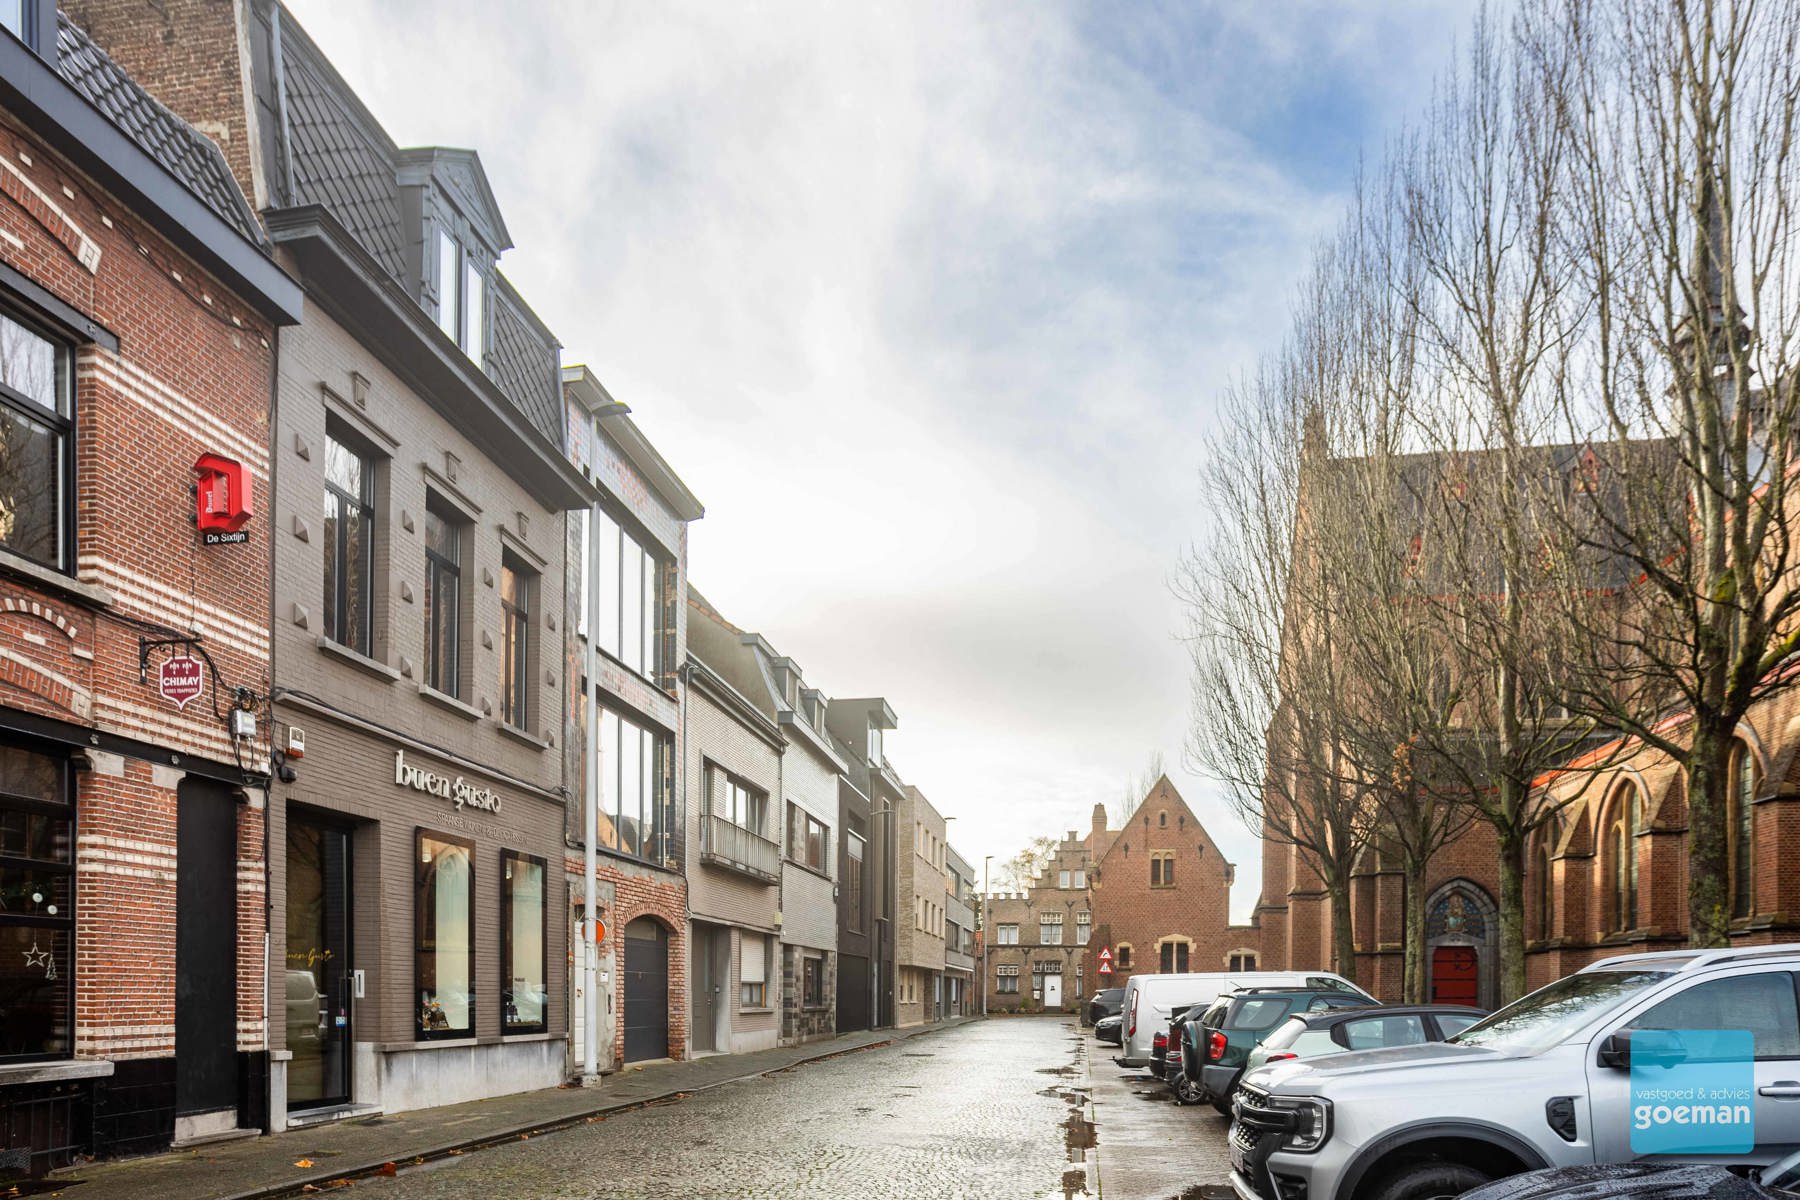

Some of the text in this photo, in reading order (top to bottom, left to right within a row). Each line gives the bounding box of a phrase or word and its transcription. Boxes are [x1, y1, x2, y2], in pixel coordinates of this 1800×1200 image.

[207, 531, 246, 543] De Sixtijn
[163, 676, 199, 686] CHIMAY
[394, 749, 502, 813] buen gusto
